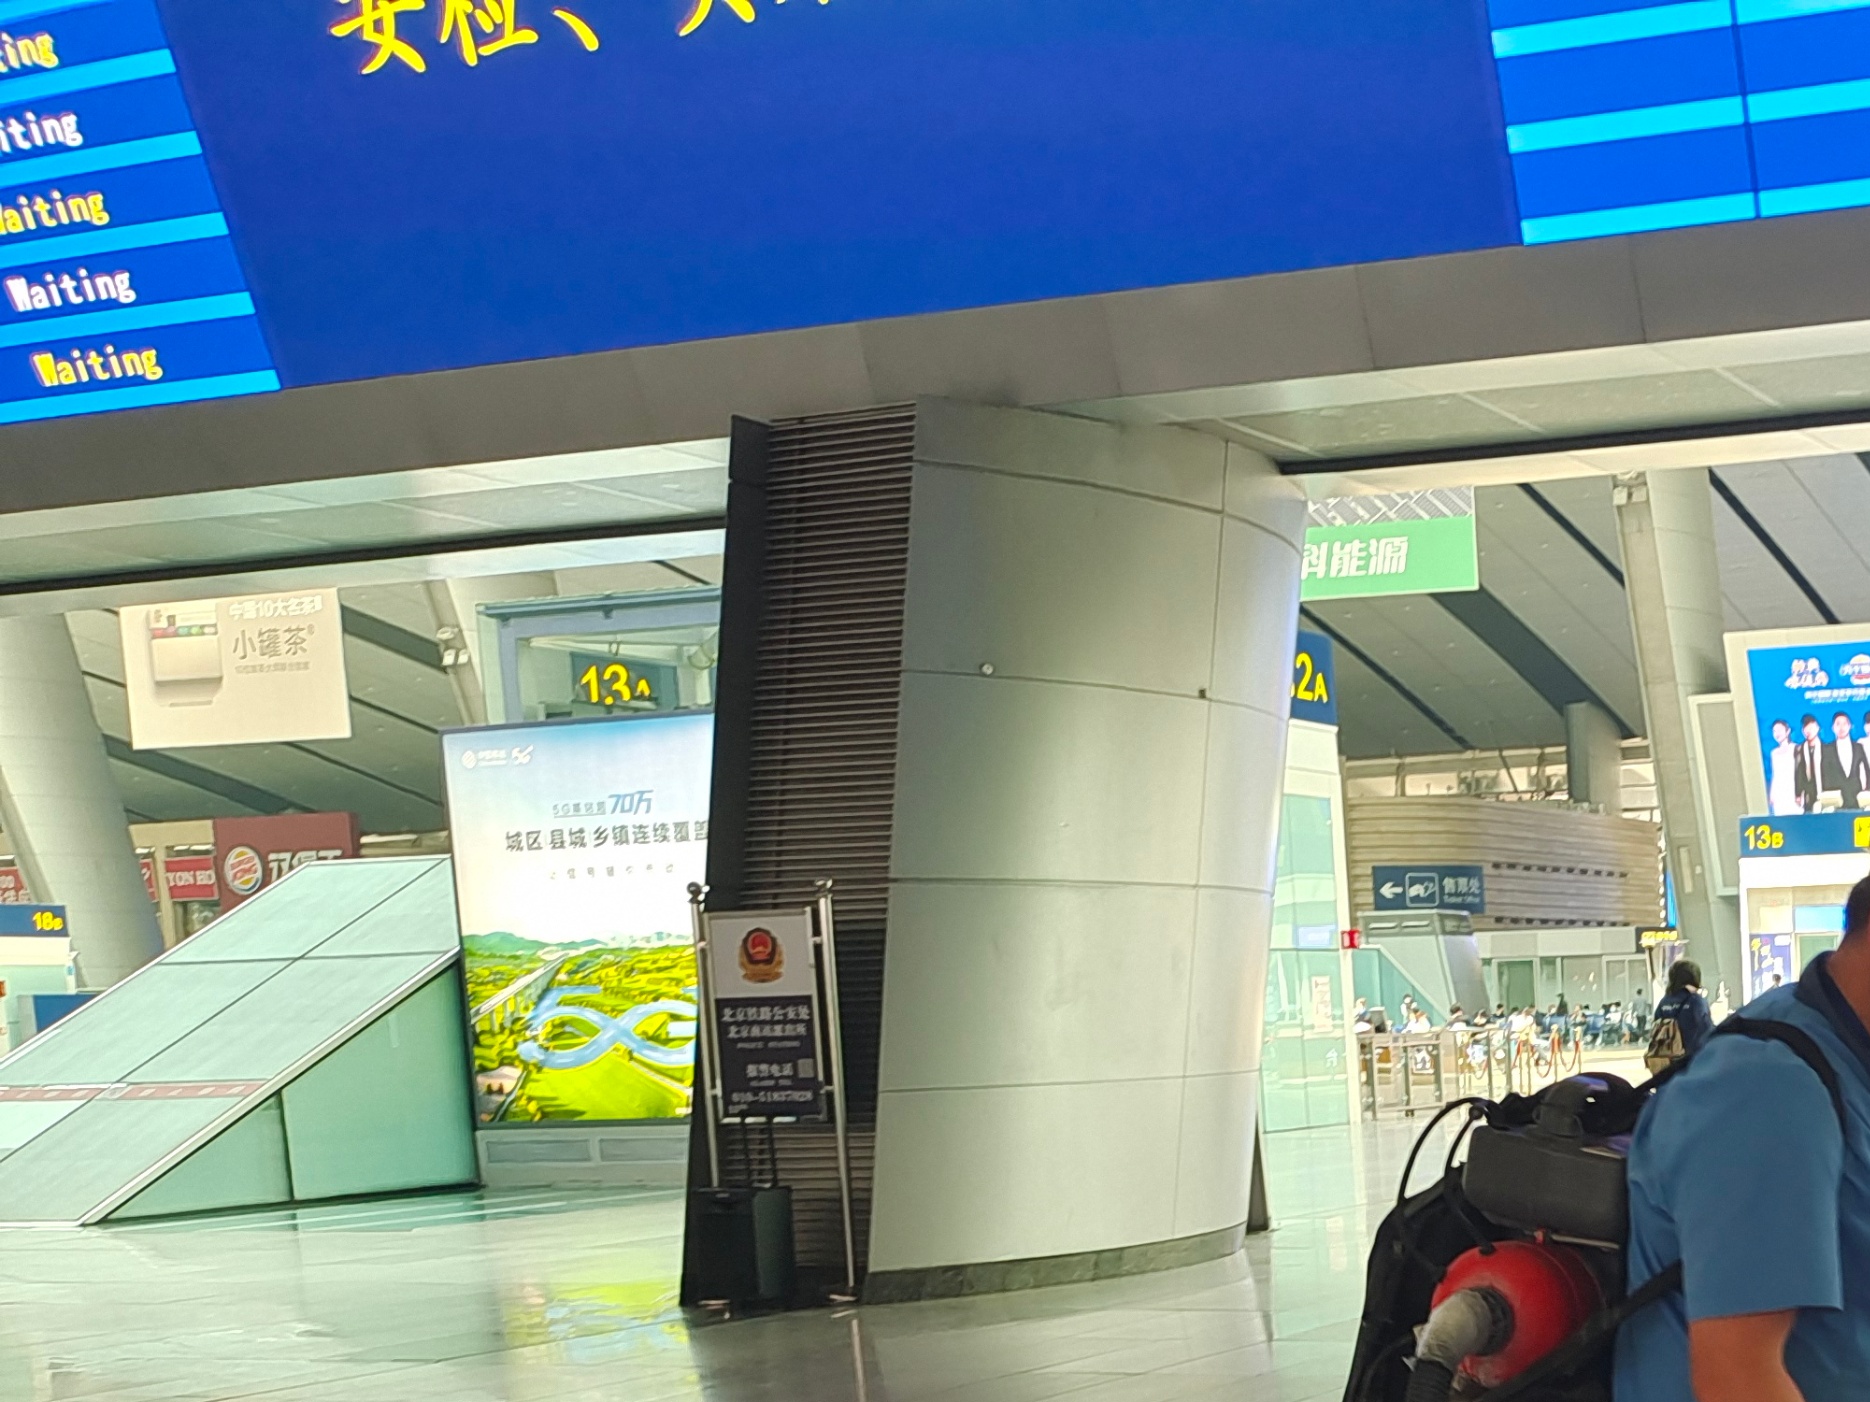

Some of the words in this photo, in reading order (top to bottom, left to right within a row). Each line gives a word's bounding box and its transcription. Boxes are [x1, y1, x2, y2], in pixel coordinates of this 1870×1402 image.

[0, 189, 109, 235] aiting
[5, 267, 137, 313] Waiting
[31, 344, 163, 388] Waiting
[1289, 652, 1328, 703] 2A
